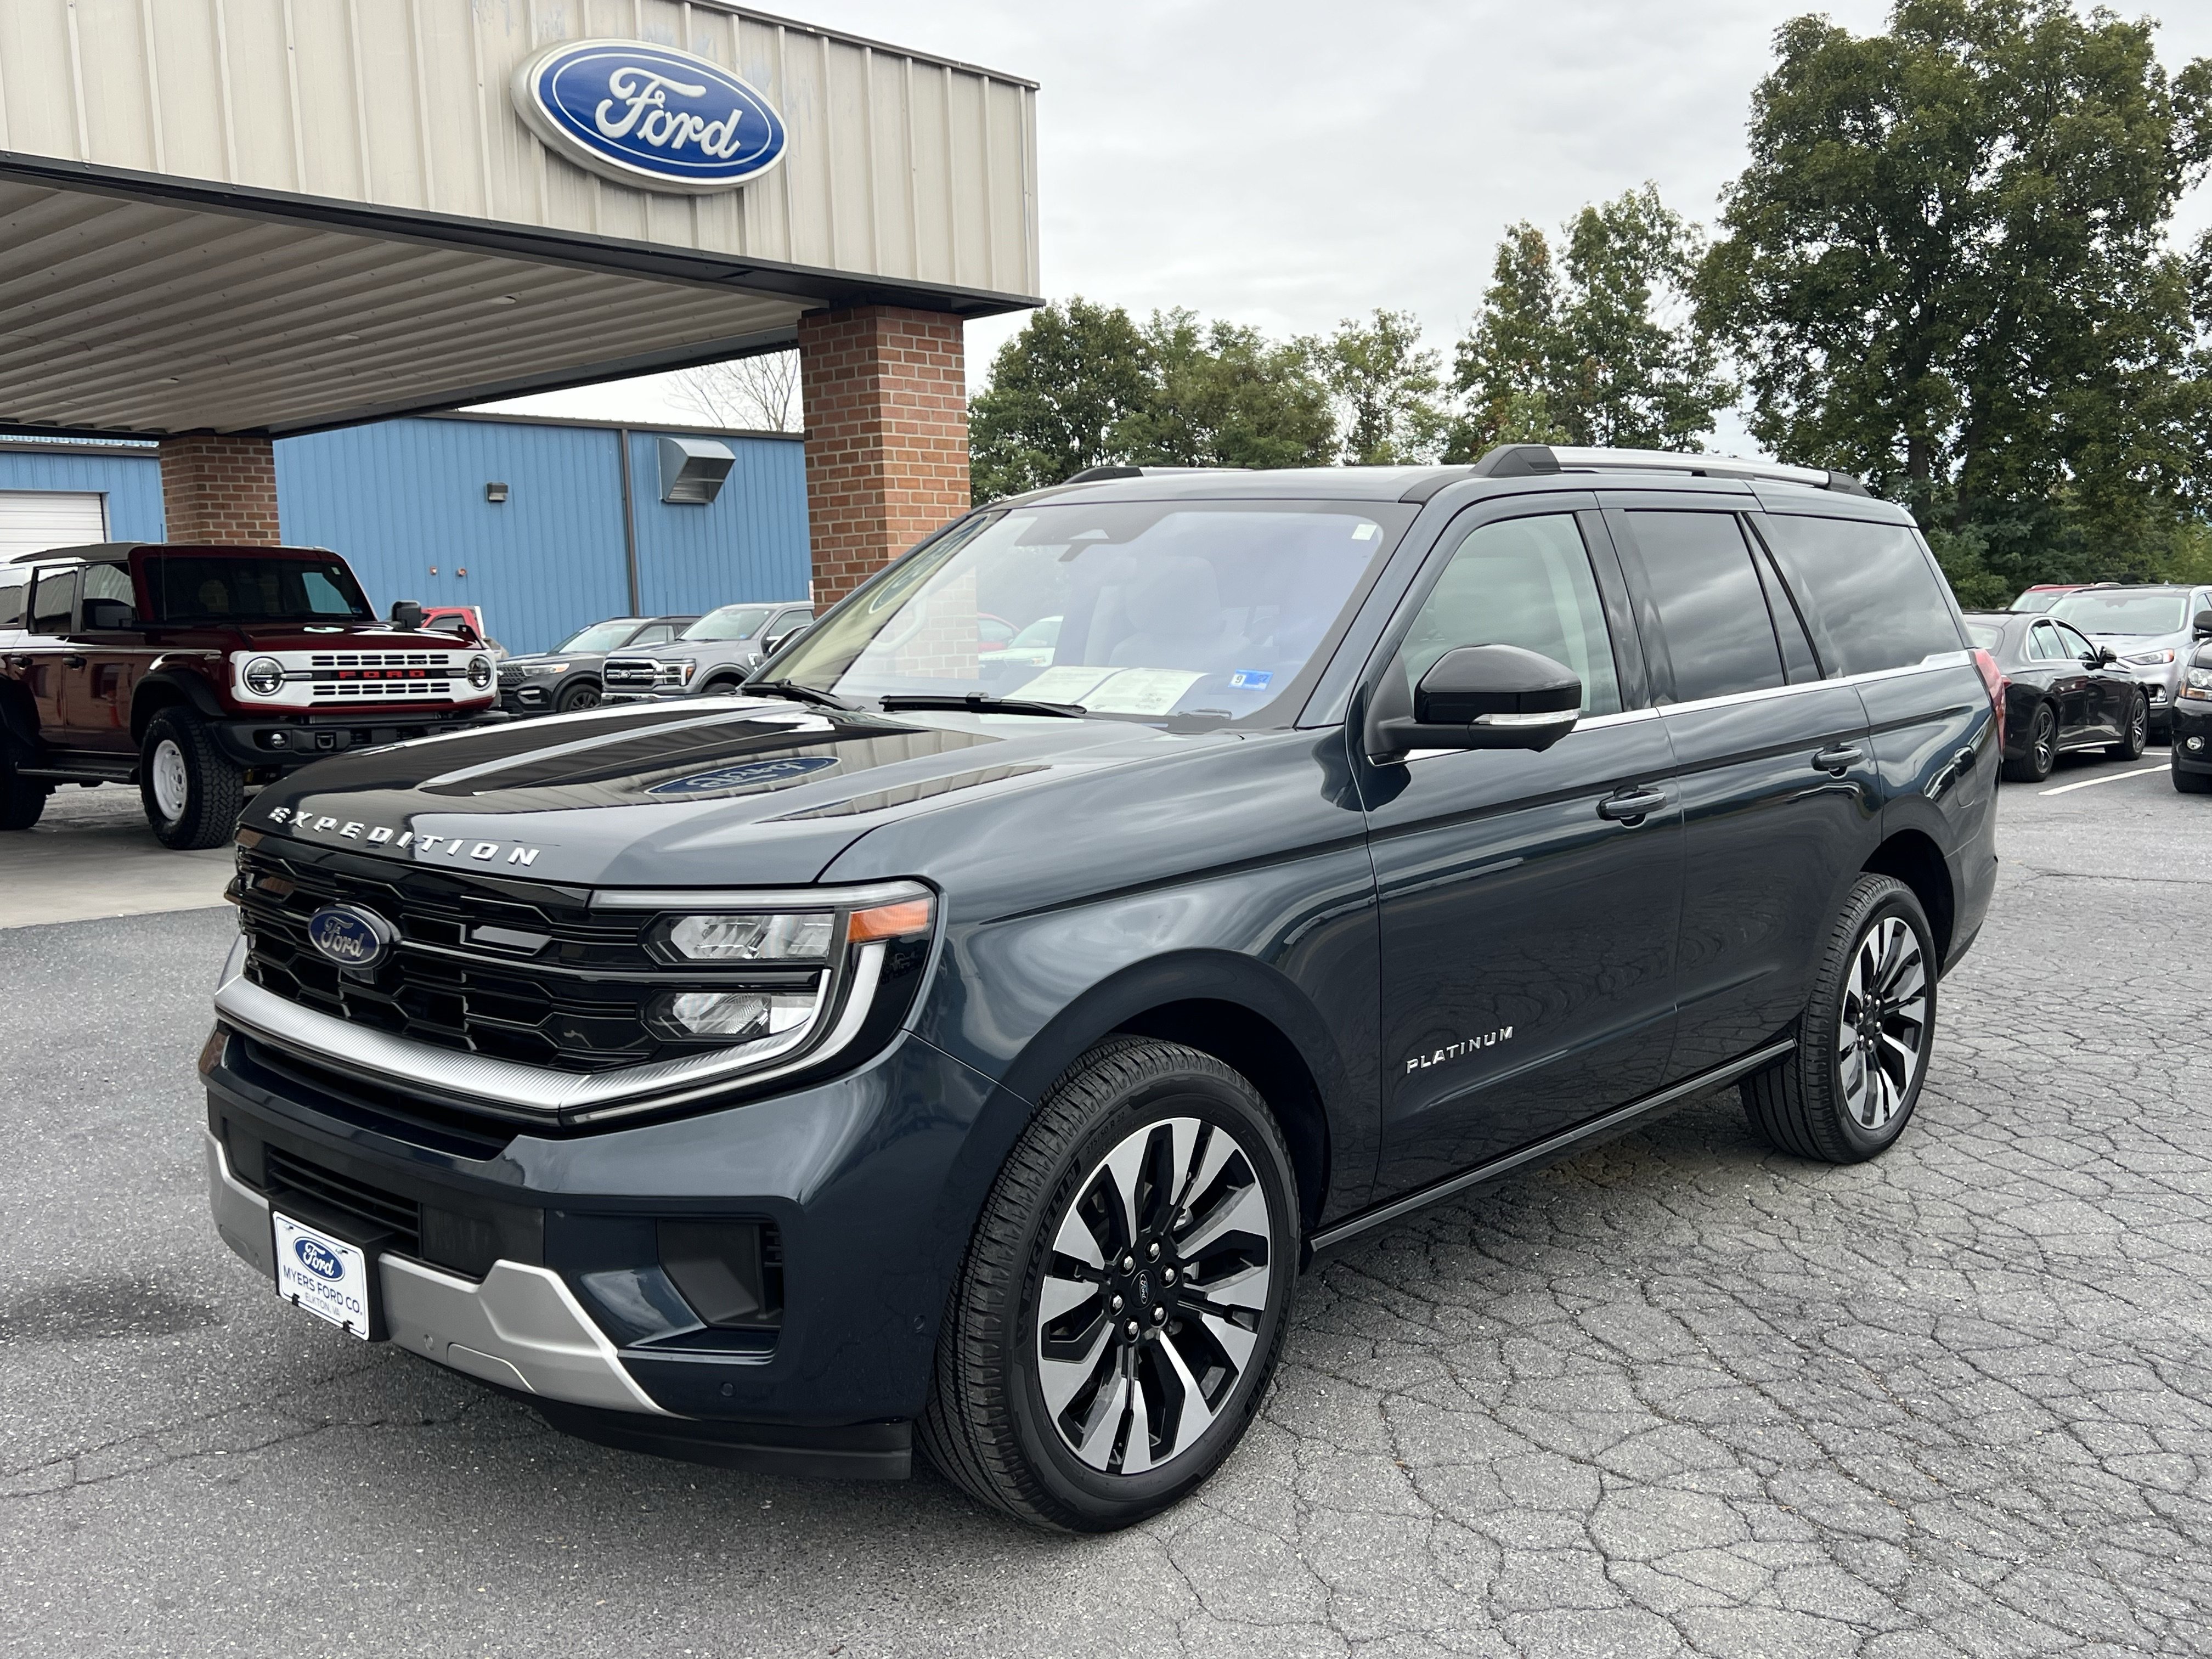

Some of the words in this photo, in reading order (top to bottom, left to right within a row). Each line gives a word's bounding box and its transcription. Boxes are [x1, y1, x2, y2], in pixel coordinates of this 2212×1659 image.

[595, 67, 743, 159] Ford
[338, 670, 425, 679] FORD
[1235, 675, 1243, 684] 9
[268, 806, 541, 867] EXPEDITION
[320, 916, 365, 957] Ford
[1406, 1025, 1514, 1074] PLATINUM
[1086, 1125, 1109, 1155] 275/50
[1110, 1119, 1115, 1128] R
[1022, 1165, 1077, 1302] MICHELIN
[302, 1242, 335, 1277] Ford
[283, 1265, 315, 1292] MYERS
[317, 1282, 343, 1306] FORD
[346, 1296, 363, 1316] CO.
[1140, 1280, 1149, 1299] Ford
[332, 1307, 341, 1317] VA
[1246, 1291, 1291, 1408] MICHELIN
